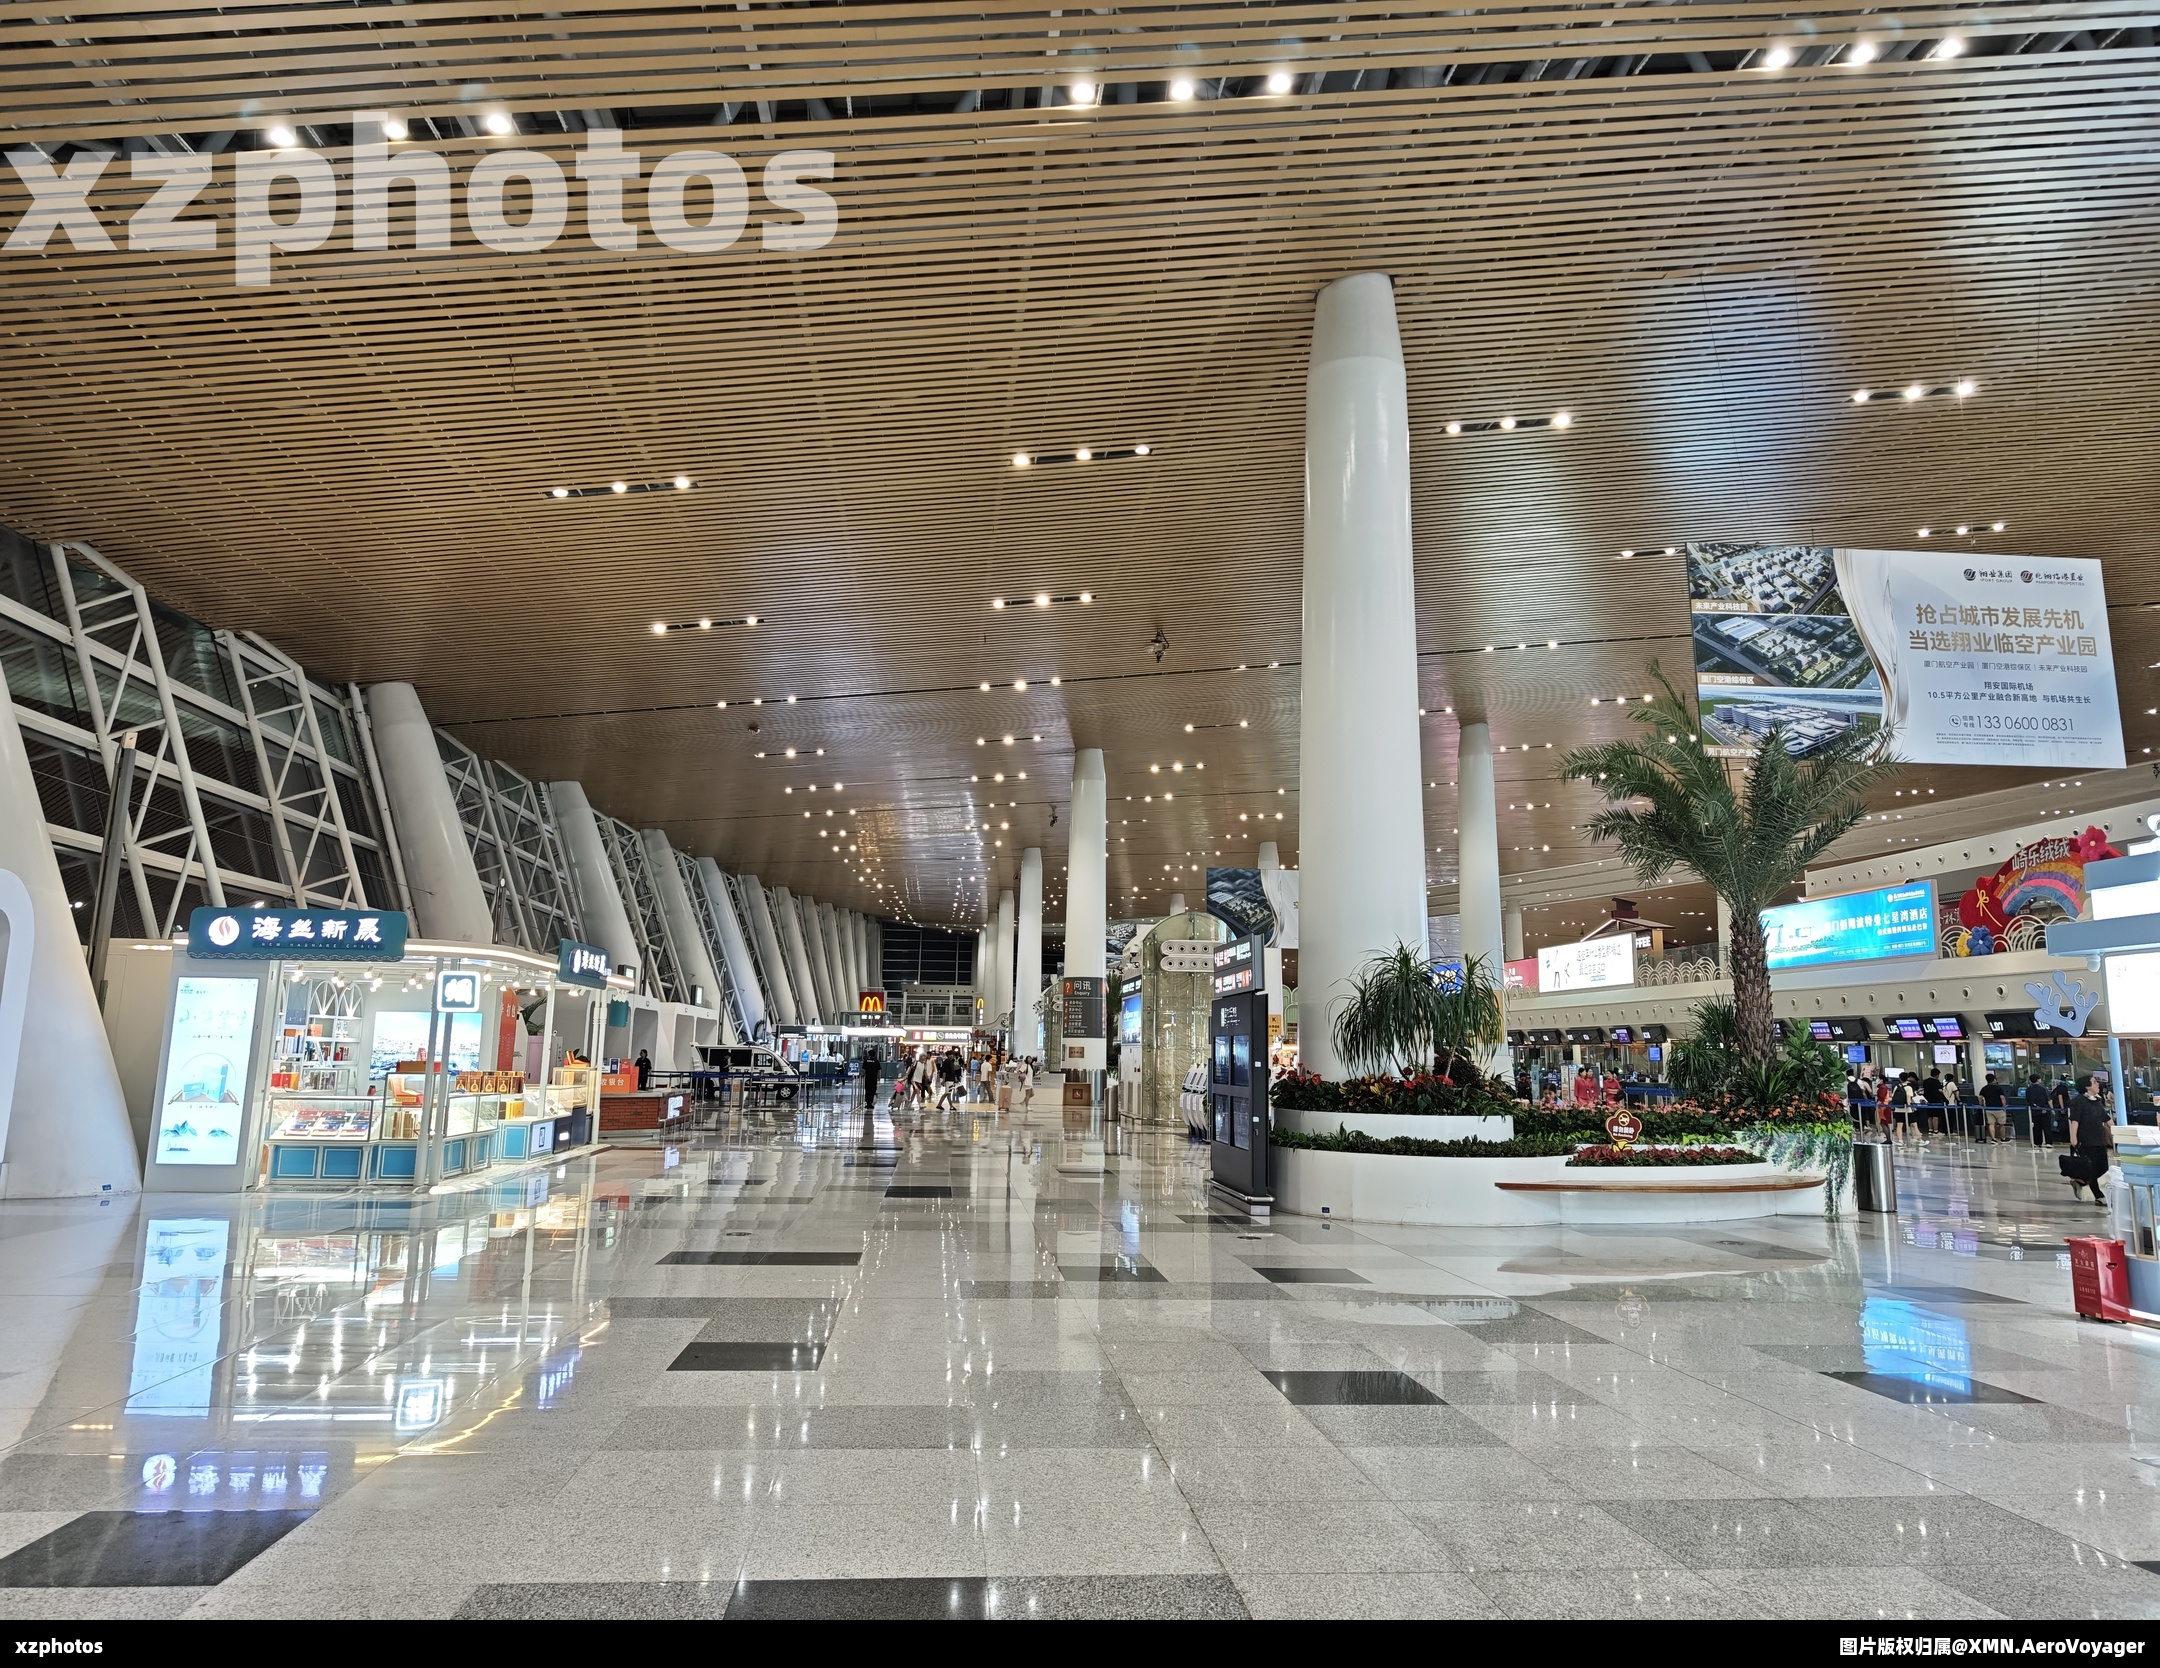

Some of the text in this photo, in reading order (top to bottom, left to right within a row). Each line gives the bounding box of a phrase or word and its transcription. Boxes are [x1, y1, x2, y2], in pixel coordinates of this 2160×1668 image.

[1695, 602, 1748, 611] 未来产业科技园
[1916, 603, 2084, 630] 抢占城市发展先机
[1909, 630, 2097, 656] 当选翔业临空产业园
[1924, 660, 2088, 673] 厦门航空产业园 厦门空港综保区 未来产业科技园
[1701, 675, 1754, 685] 厦门空港综保区
[1984, 681, 2034, 691] 翔安国际机场
[1928, 691, 2091, 704] 10.5平方公里产业融合新高地 与机场共生长
[1976, 715, 2074, 731] 133 0600 0831
[1707, 747, 1759, 758] 厦门航空产业
[2012, 837, 2071, 880] 崎乐绒绒
[1074, 981, 1091, 990] 问讯
[1832, 1026, 1844, 1034] L04
[1887, 1025, 1900, 1034] L05
[1923, 1023, 1937, 1033] L06
[1989, 1021, 2004, 1031] L07
